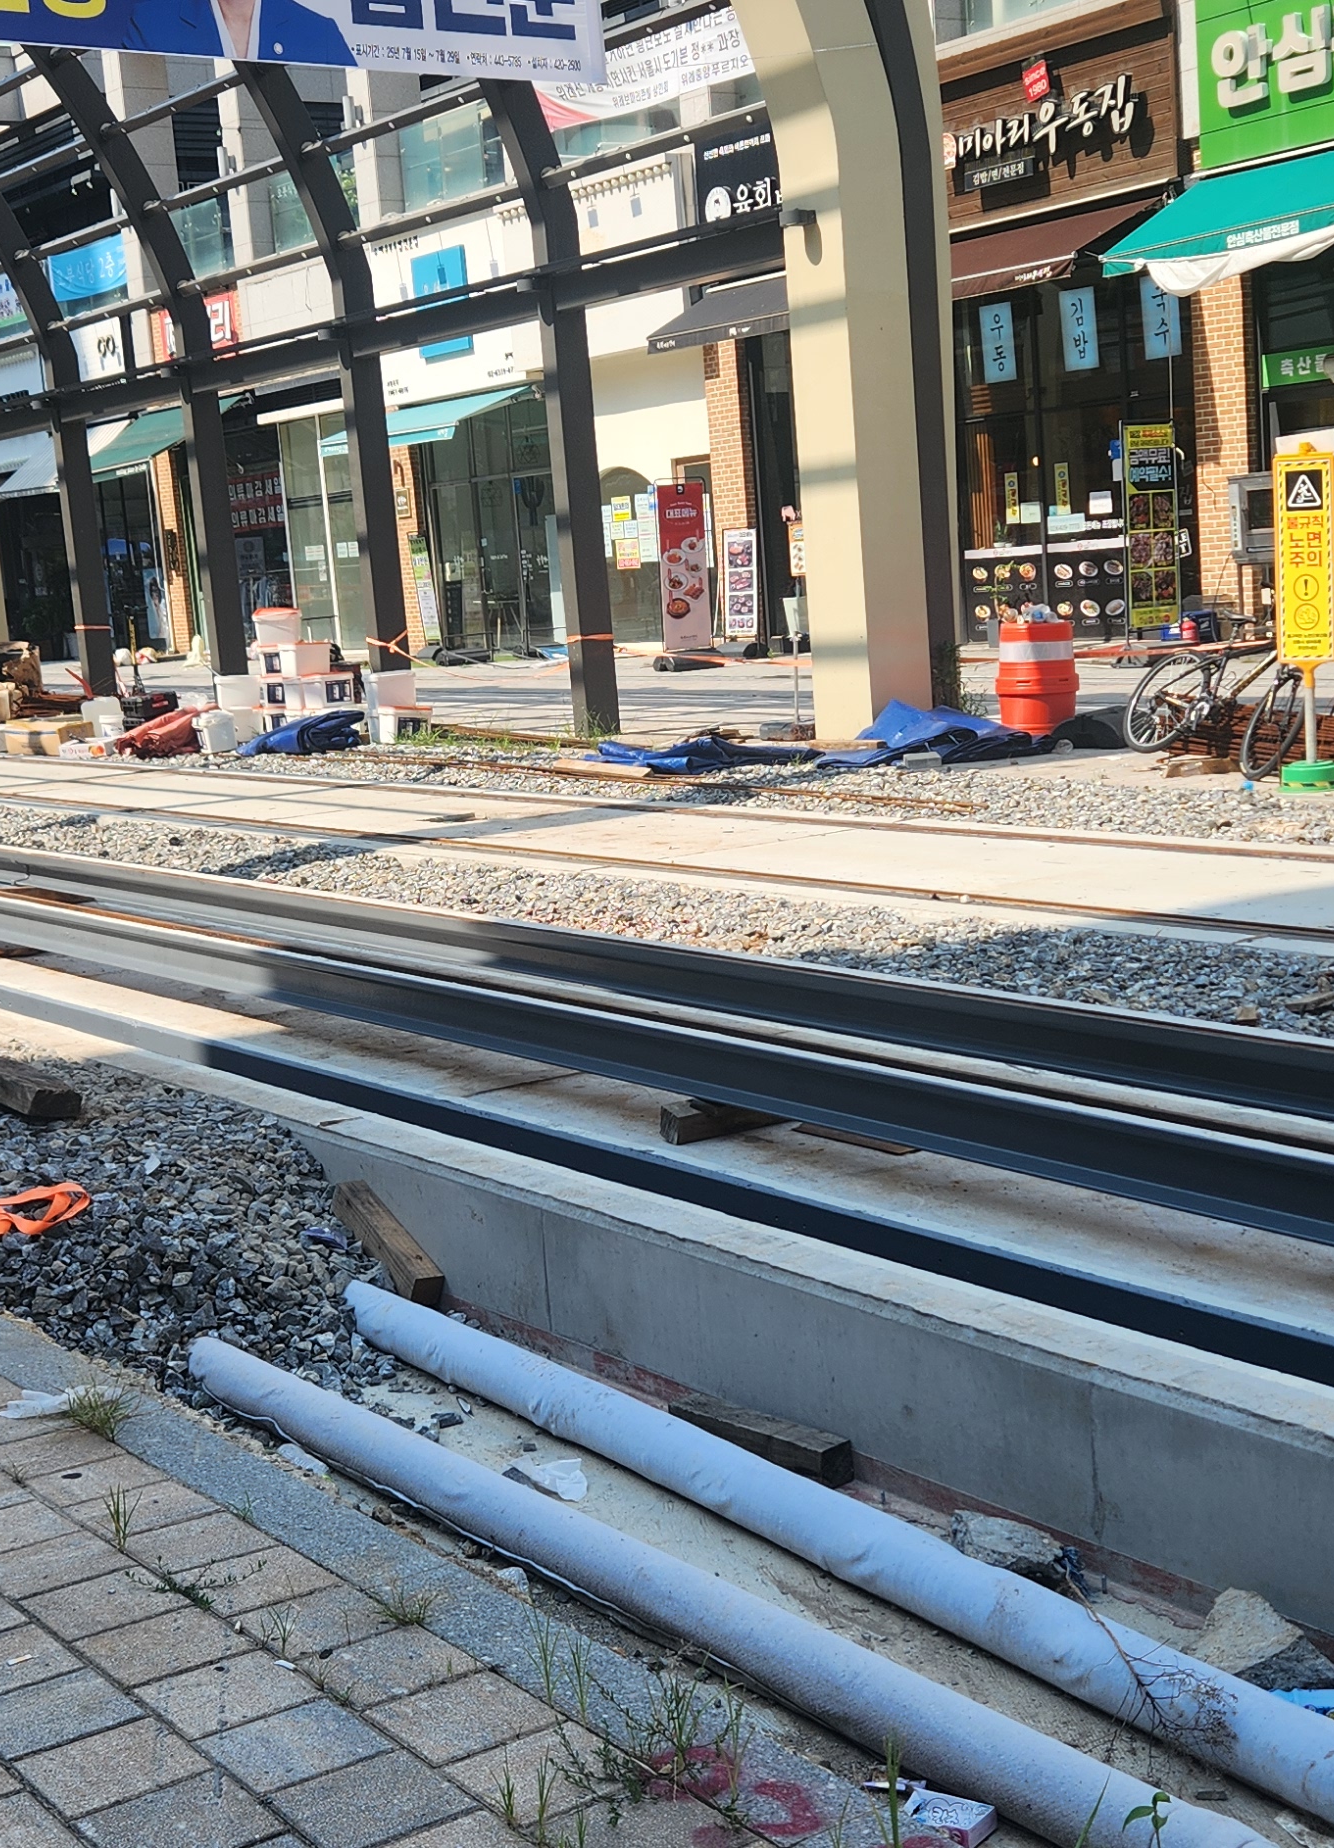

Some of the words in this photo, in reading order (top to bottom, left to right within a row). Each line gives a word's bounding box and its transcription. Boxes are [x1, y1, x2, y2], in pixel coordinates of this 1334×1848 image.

[1070, 297, 1089, 360] 김밥
[989, 312, 1008, 373] 우동
[1286, 515, 1324, 529] 불규칙
[1289, 531, 1323, 549] 노면
[1289, 550, 1323, 568] 주의
